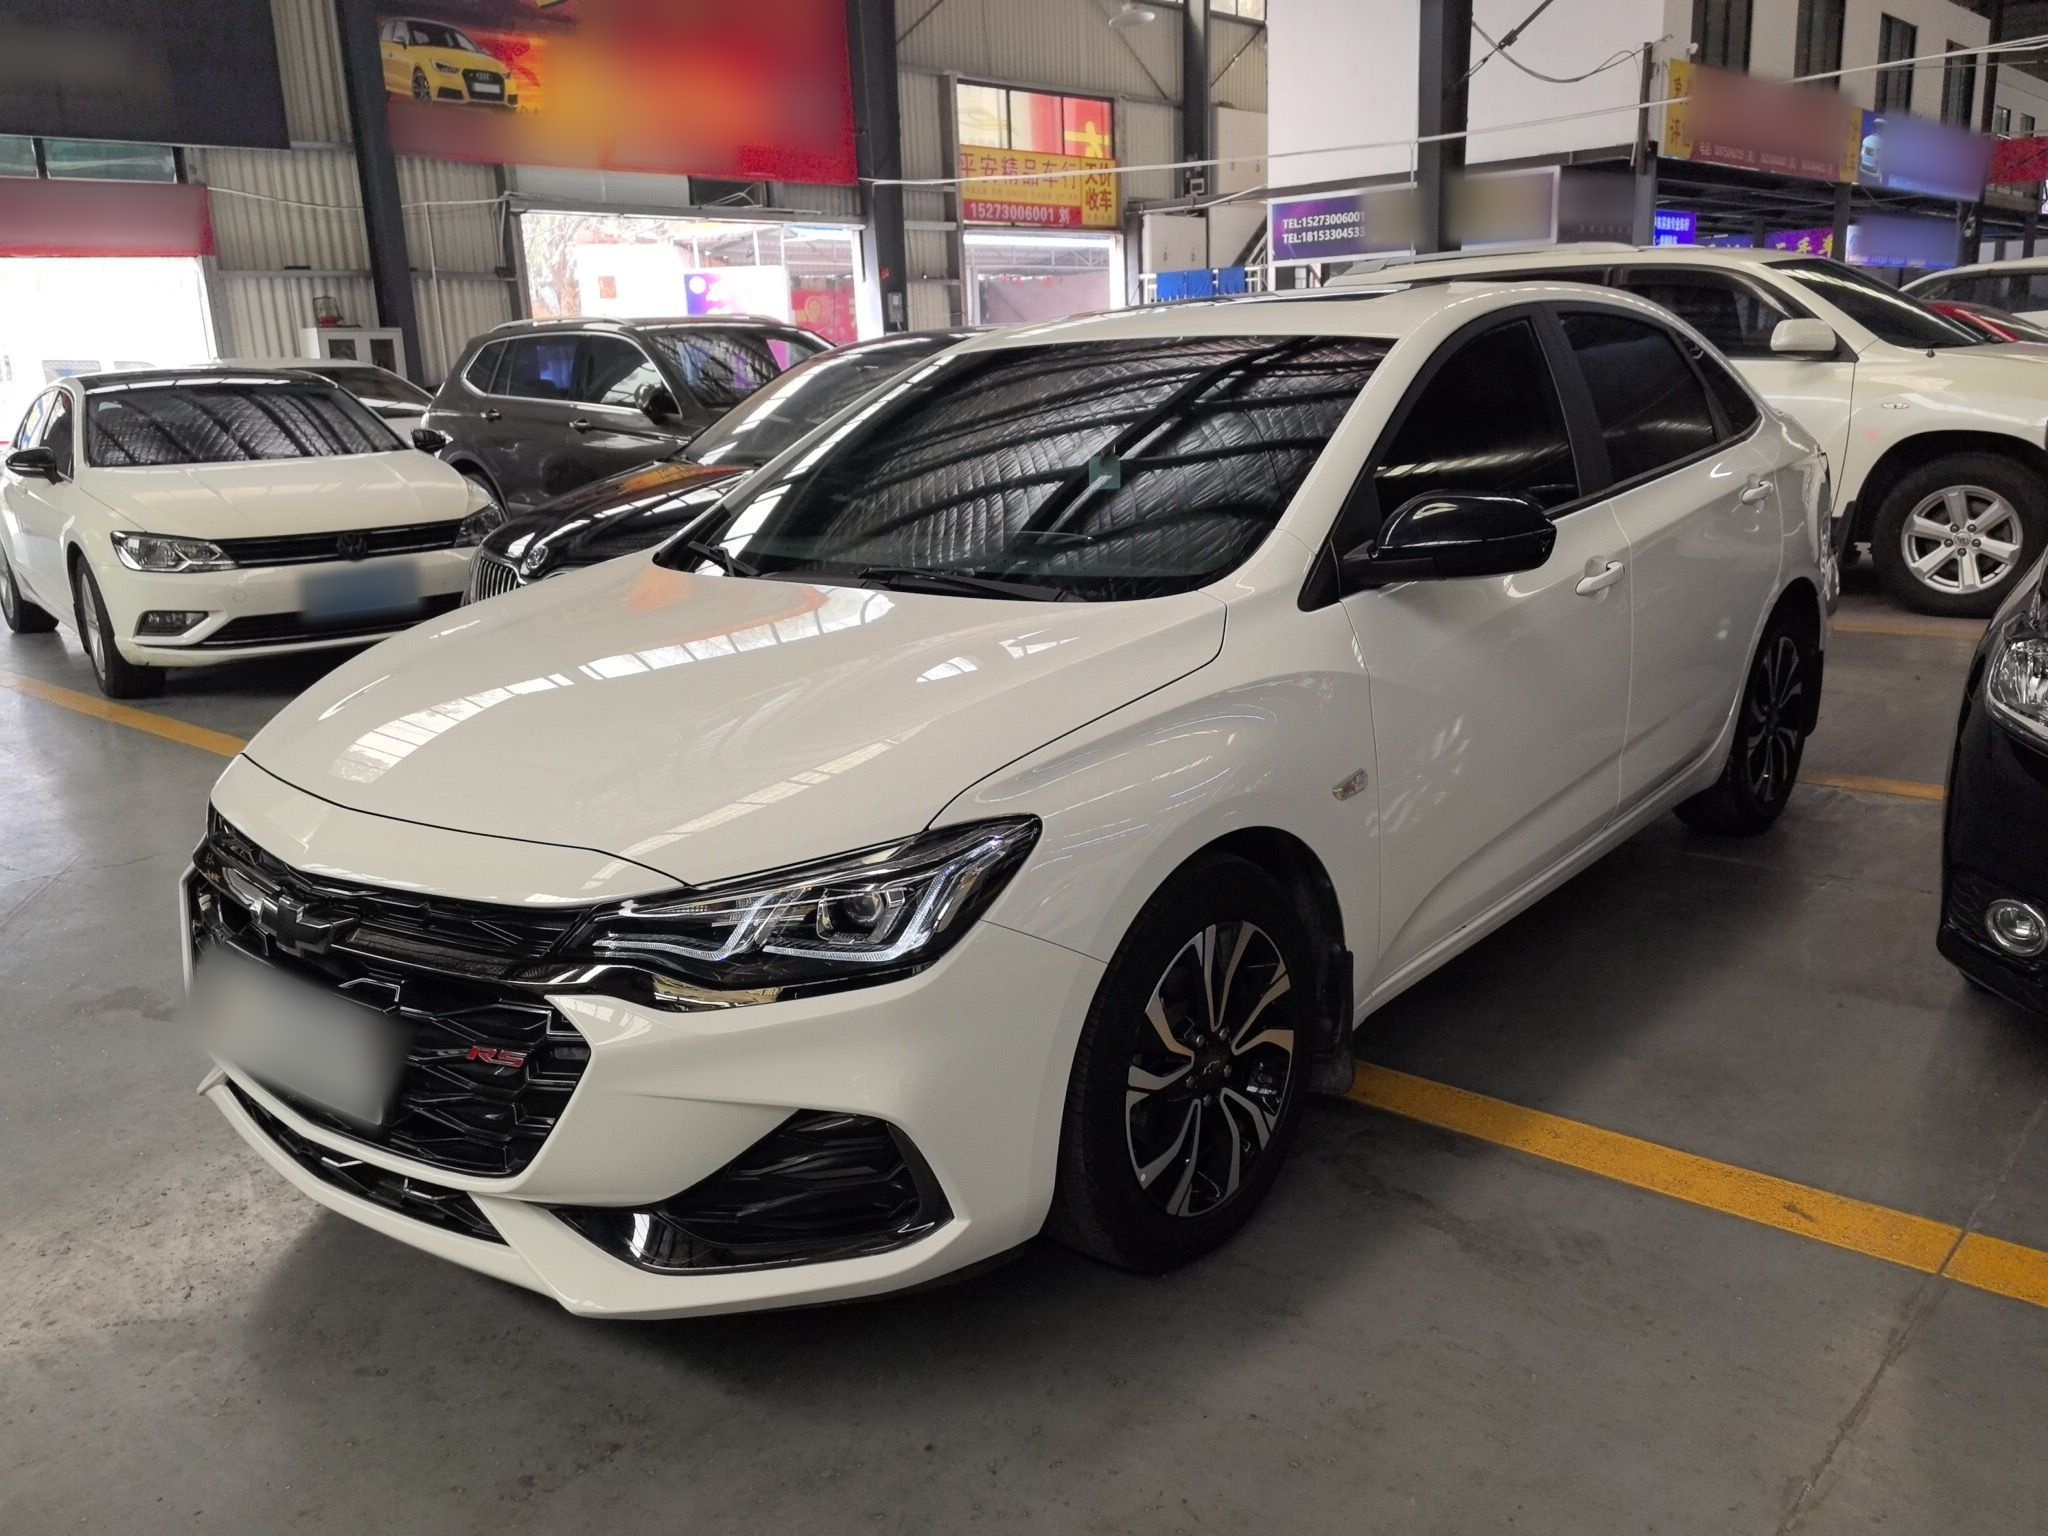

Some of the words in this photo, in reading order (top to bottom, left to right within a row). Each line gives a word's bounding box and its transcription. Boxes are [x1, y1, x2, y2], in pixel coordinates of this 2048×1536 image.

[969, 202, 1055, 222] 15273006001
[1282, 211, 1365, 230] TEL:15273006001
[466, 1045, 529, 1068] RS
